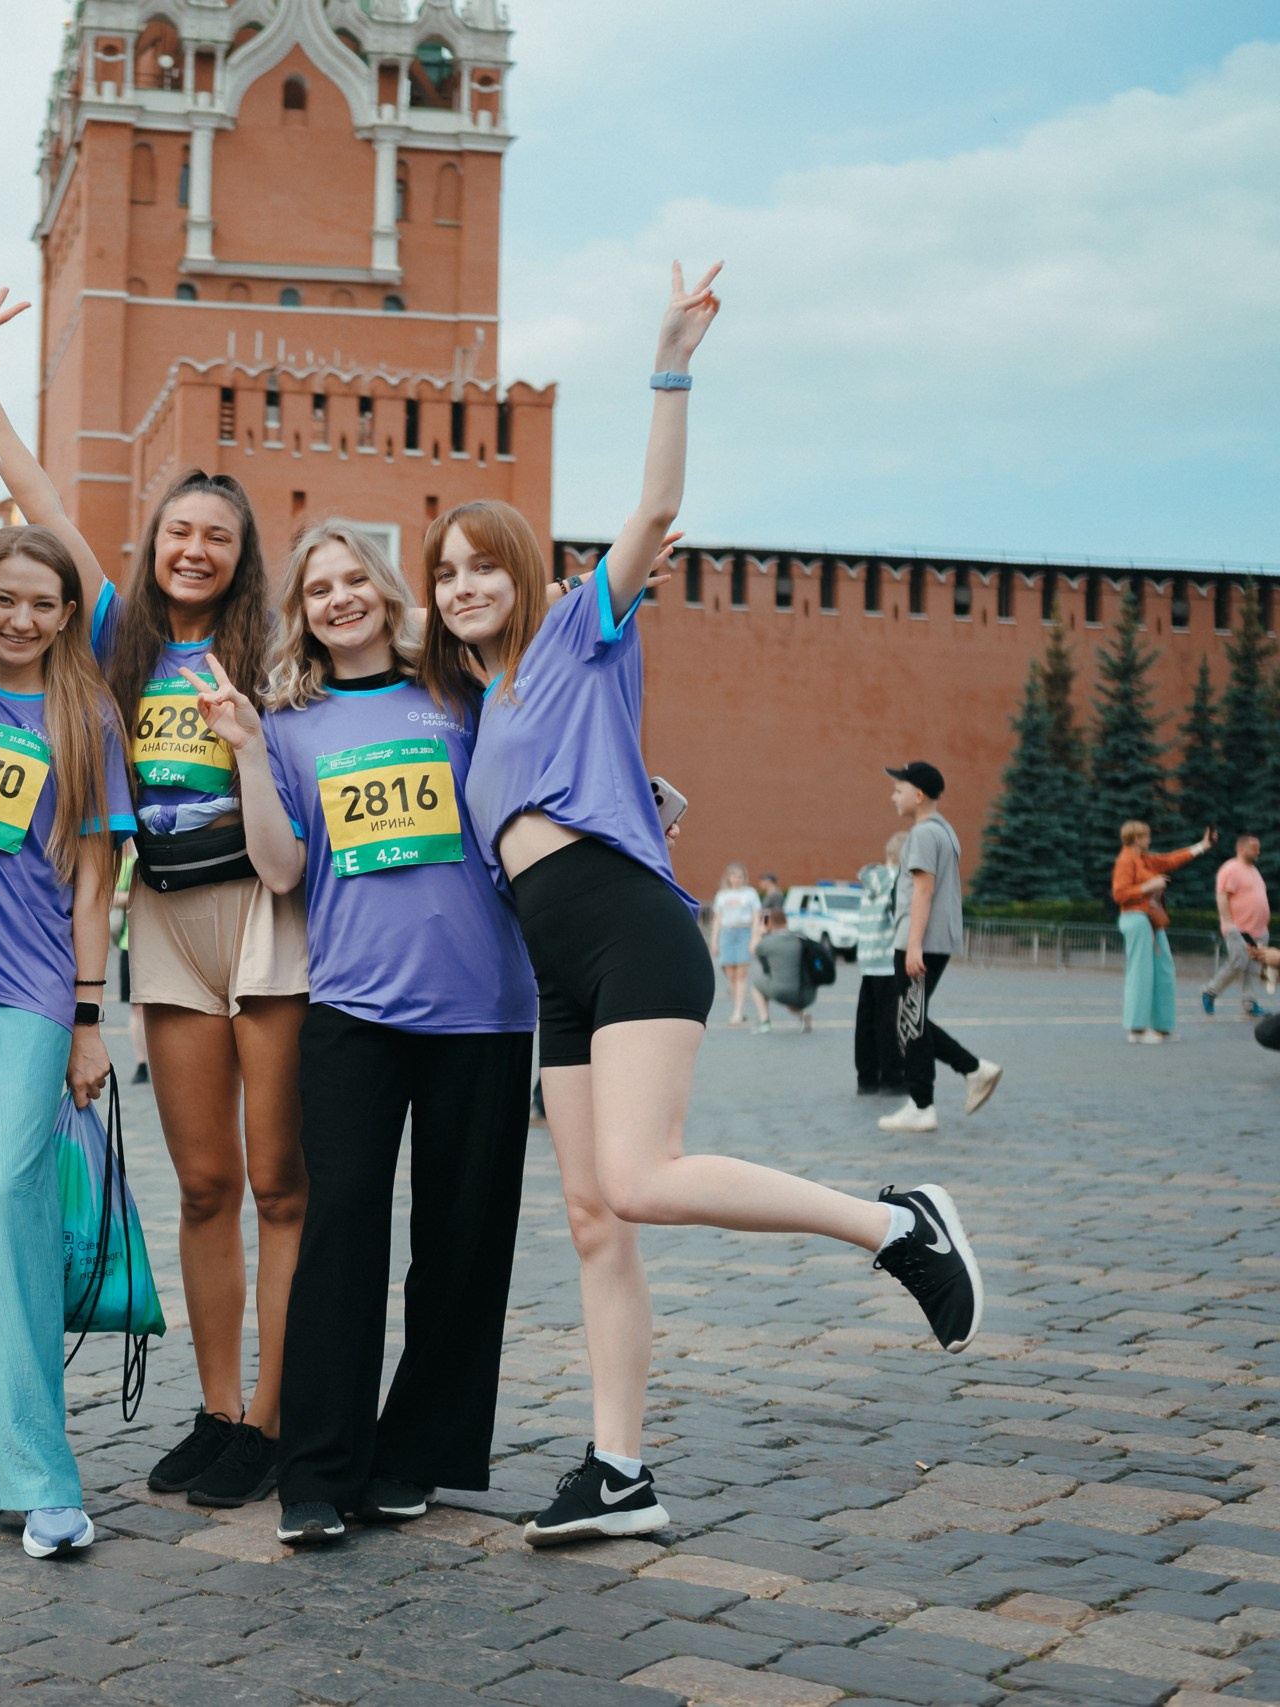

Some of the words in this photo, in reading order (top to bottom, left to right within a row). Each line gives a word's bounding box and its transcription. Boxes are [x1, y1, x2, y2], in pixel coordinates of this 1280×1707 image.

[421, 712, 447, 720] СБЕР
[140, 742, 207, 755] АНАСТАСИЯ
[340, 774, 438, 823] 2816
[370, 816, 416, 832] ИРИНА
